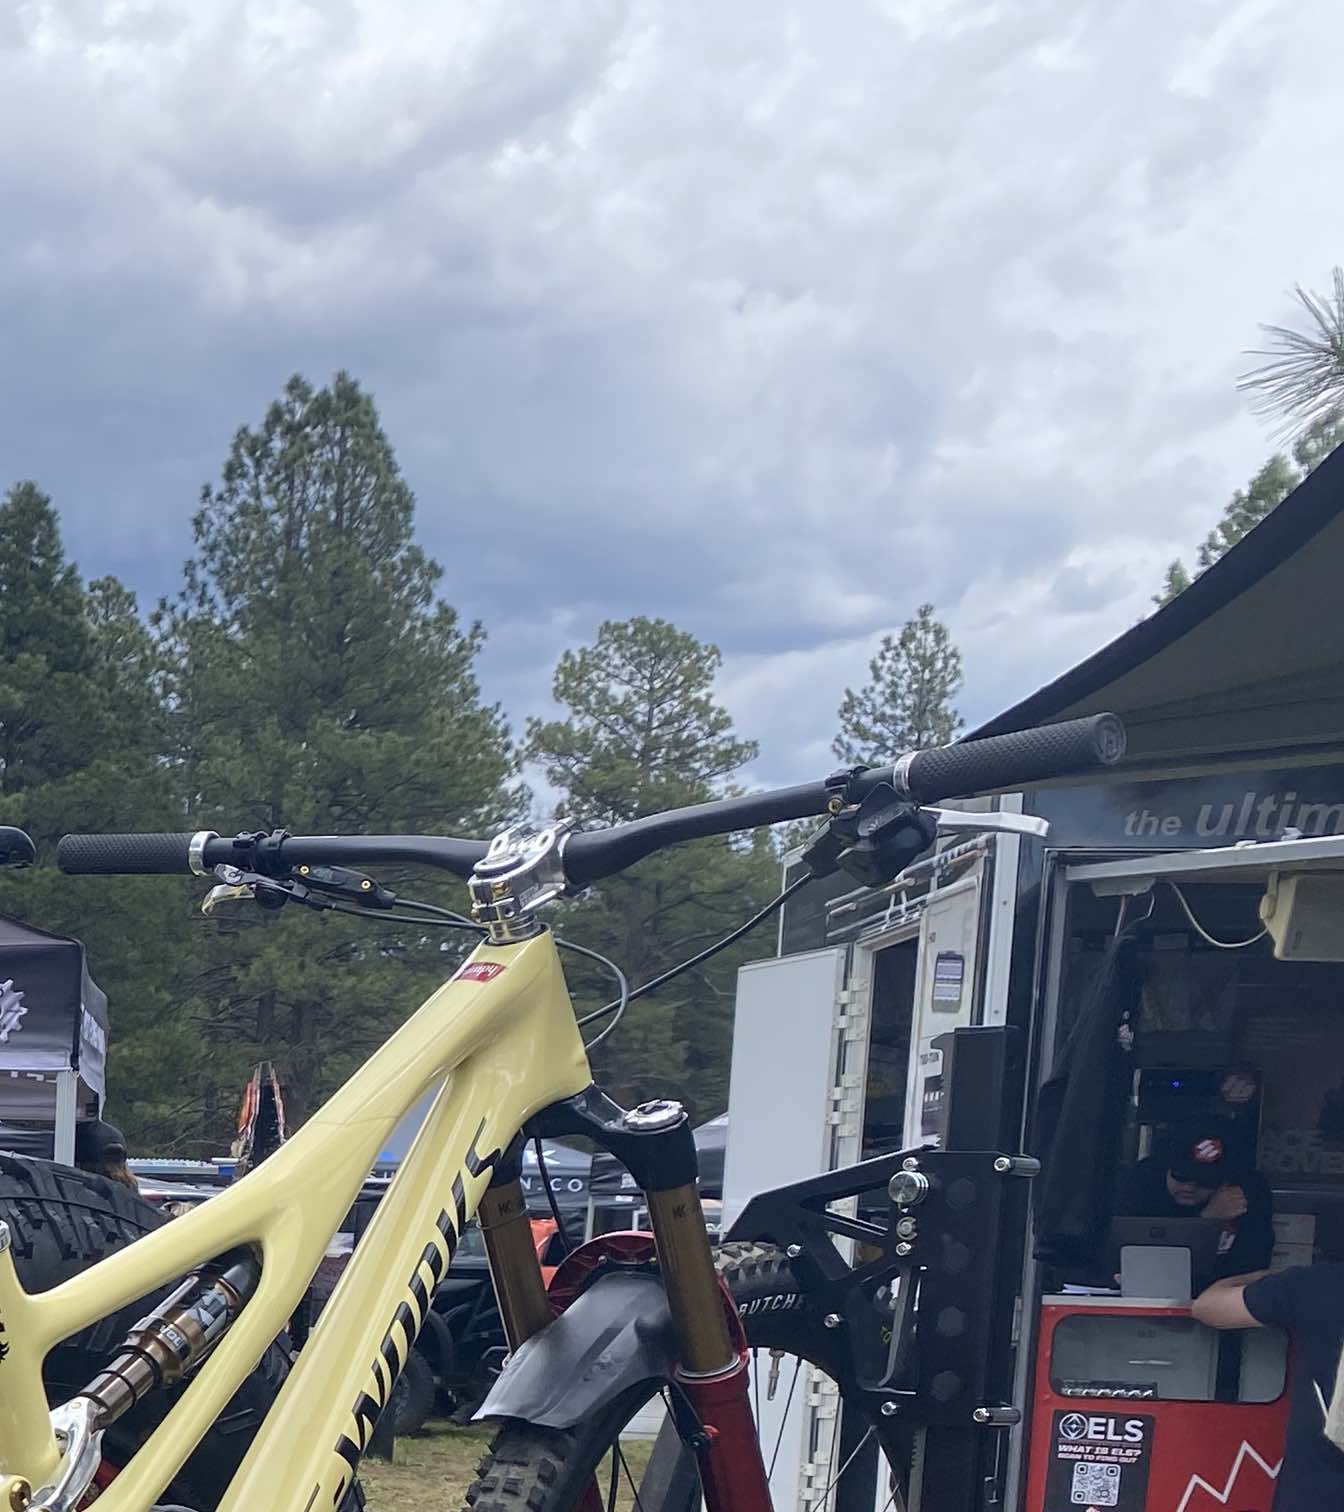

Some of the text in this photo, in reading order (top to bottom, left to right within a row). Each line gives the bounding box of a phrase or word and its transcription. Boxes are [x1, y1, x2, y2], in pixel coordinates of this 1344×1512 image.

[1125, 810, 1182, 836] the
[1087, 1417, 1144, 1442] ELS
[1058, 1444, 1142, 1457] WHAT IS ELS?
